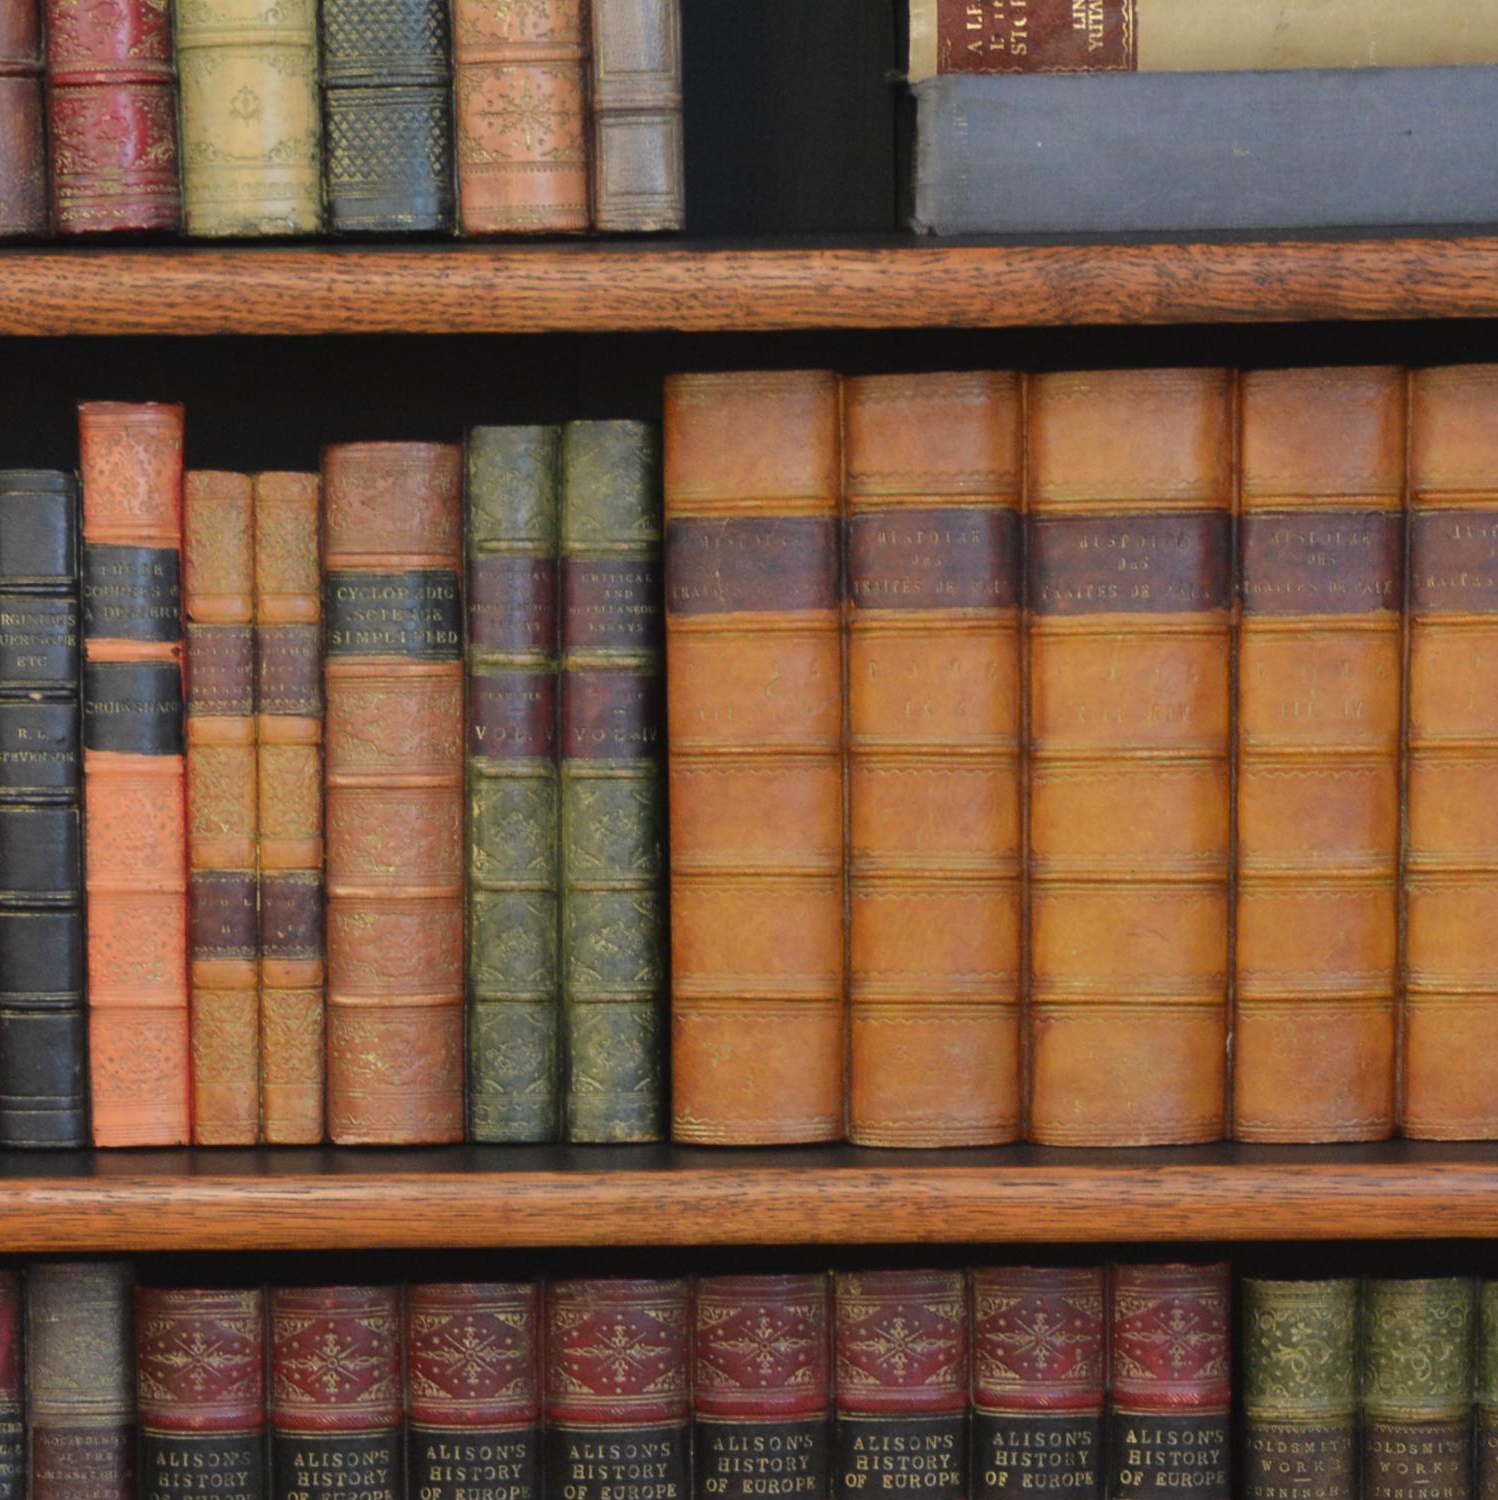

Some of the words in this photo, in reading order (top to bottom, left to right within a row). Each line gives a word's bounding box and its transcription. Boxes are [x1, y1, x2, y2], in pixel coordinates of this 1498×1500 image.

[1087, 0, 1104, 52] YUTA
[966, 40, 983, 55] A
[580, 573, 653, 584] CRITICAL
[84, 583, 163, 599] COURSES
[603, 589, 634, 601] AND
[84, 607, 95, 621] A
[587, 622, 644, 633] ESSAYS
[332, 630, 460, 645] SIMPLIFIED
[712, 1434, 815, 1453] ALISON'S
[852, 1434, 955, 1453] ALISON'S
[991, 1431, 1094, 1449] ALISON'S
[1125, 1429, 1225, 1447] ALISON'S
[156, 1451, 252, 1470] ALISON'S
[293, 1449, 391, 1469] ALISON'S
[425, 1444, 528, 1462] ALISON'S
[568, 1441, 672, 1461] ALISON'S
[994, 1449, 1089, 1468] HISTORY
[1128, 1449, 1221, 1467] HISTORY
[572, 1462, 669, 1481] HISTORY
[717, 1454, 812, 1474] HISTORY
[855, 1453, 952, 1472] HISTORY
[1260, 1458, 1342, 1474] WORKS
[1379, 1459, 1459, 1476] WORKS
[158, 1471, 250, 1490] HISTORY
[296, 1468, 389, 1488] HISTORY
[429, 1464, 524, 1482] HISTORY
[844, 1473, 869, 1490] OF
[881, 1471, 961, 1490] EUROPE
[984, 1470, 1010, 1488] OF
[1021, 1470, 1095, 1489] EUROPE
[1119, 1469, 1145, 1487] OF
[1156, 1469, 1227, 1488] EUROPE
[705, 1477, 730, 1495] OF
[741, 1475, 818, 1495] EUROPE
